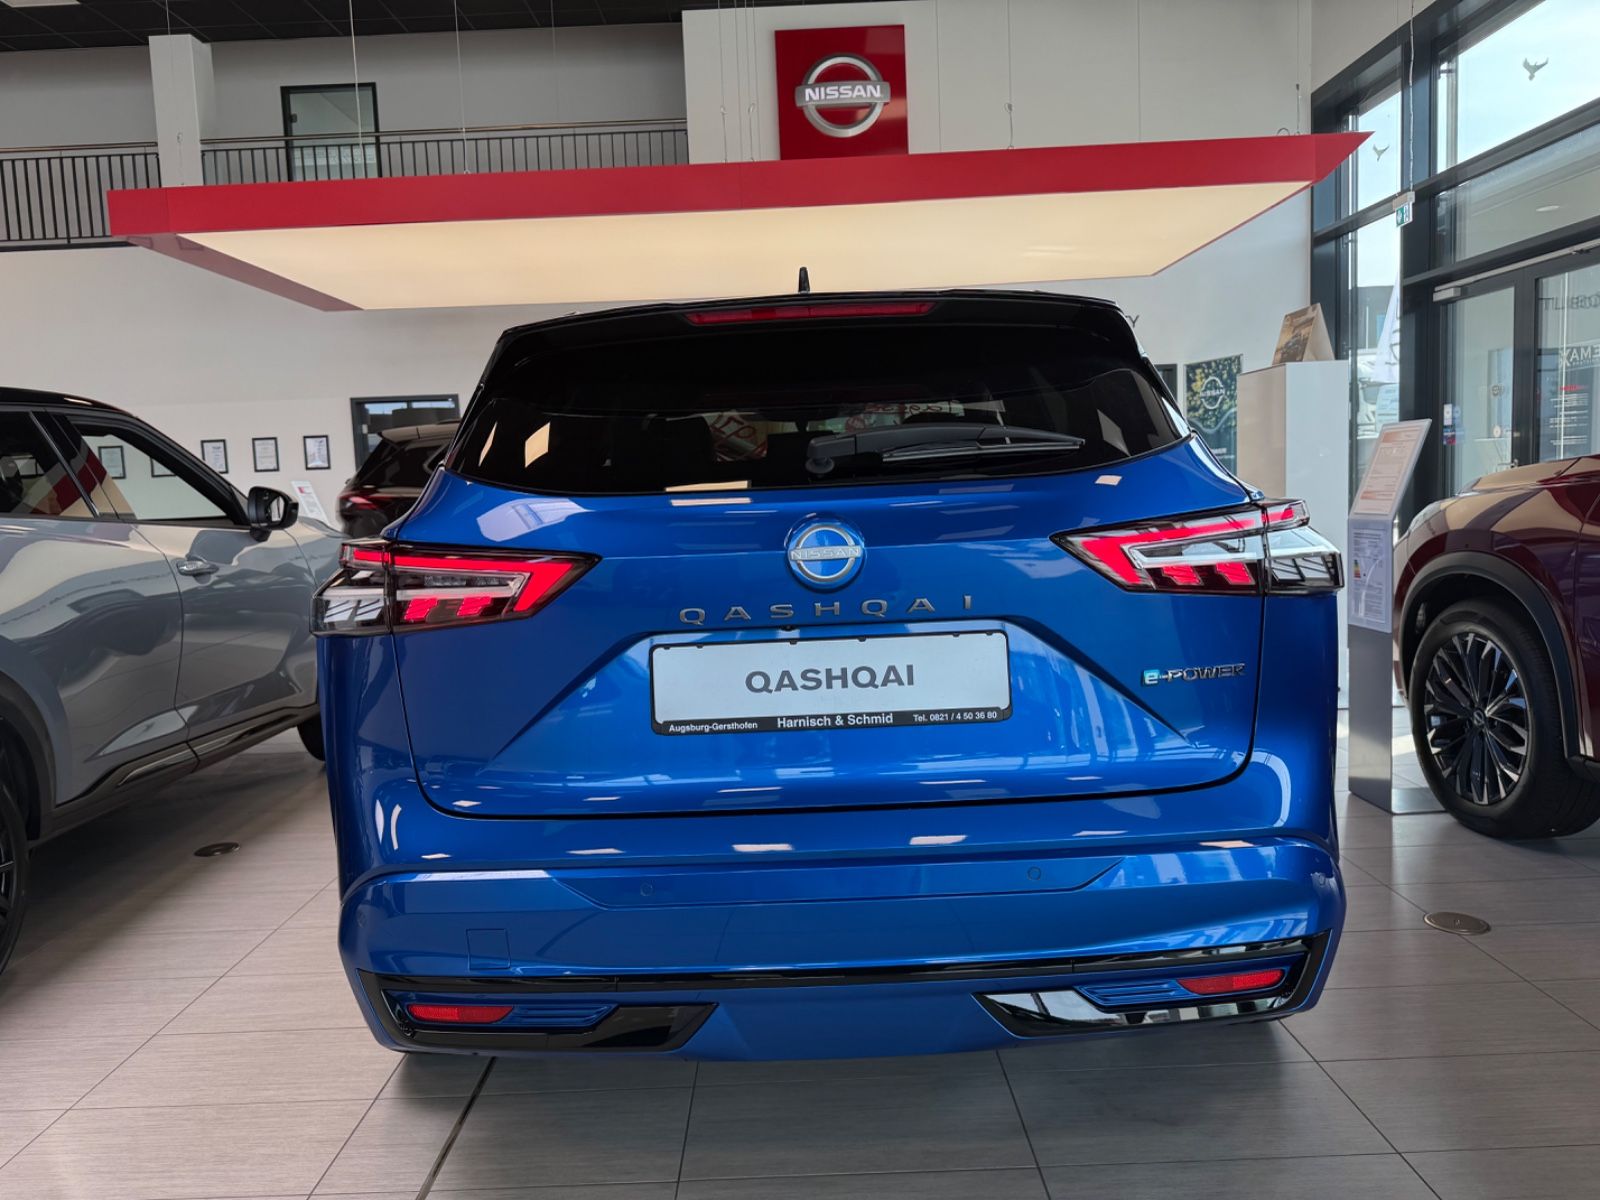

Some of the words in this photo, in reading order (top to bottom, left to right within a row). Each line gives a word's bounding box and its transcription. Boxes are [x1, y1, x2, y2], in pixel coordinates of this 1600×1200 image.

[804, 84, 882, 102] NISSAN
[790, 546, 861, 561] NISSAN
[679, 595, 973, 626] QASHQAI
[745, 664, 915, 694] QASHQAI
[777, 715, 832, 728] Harnisch
[835, 715, 844, 726] &
[847, 713, 894, 725] Schmid
[913, 713, 927, 722] Tel.
[929, 712, 950, 721] 0821
[956, 712, 962, 720] 4
[963, 711, 974, 720] 50
[987, 710, 998, 719] 80
[669, 722, 758, 734] Augsburg-Gersthofen
